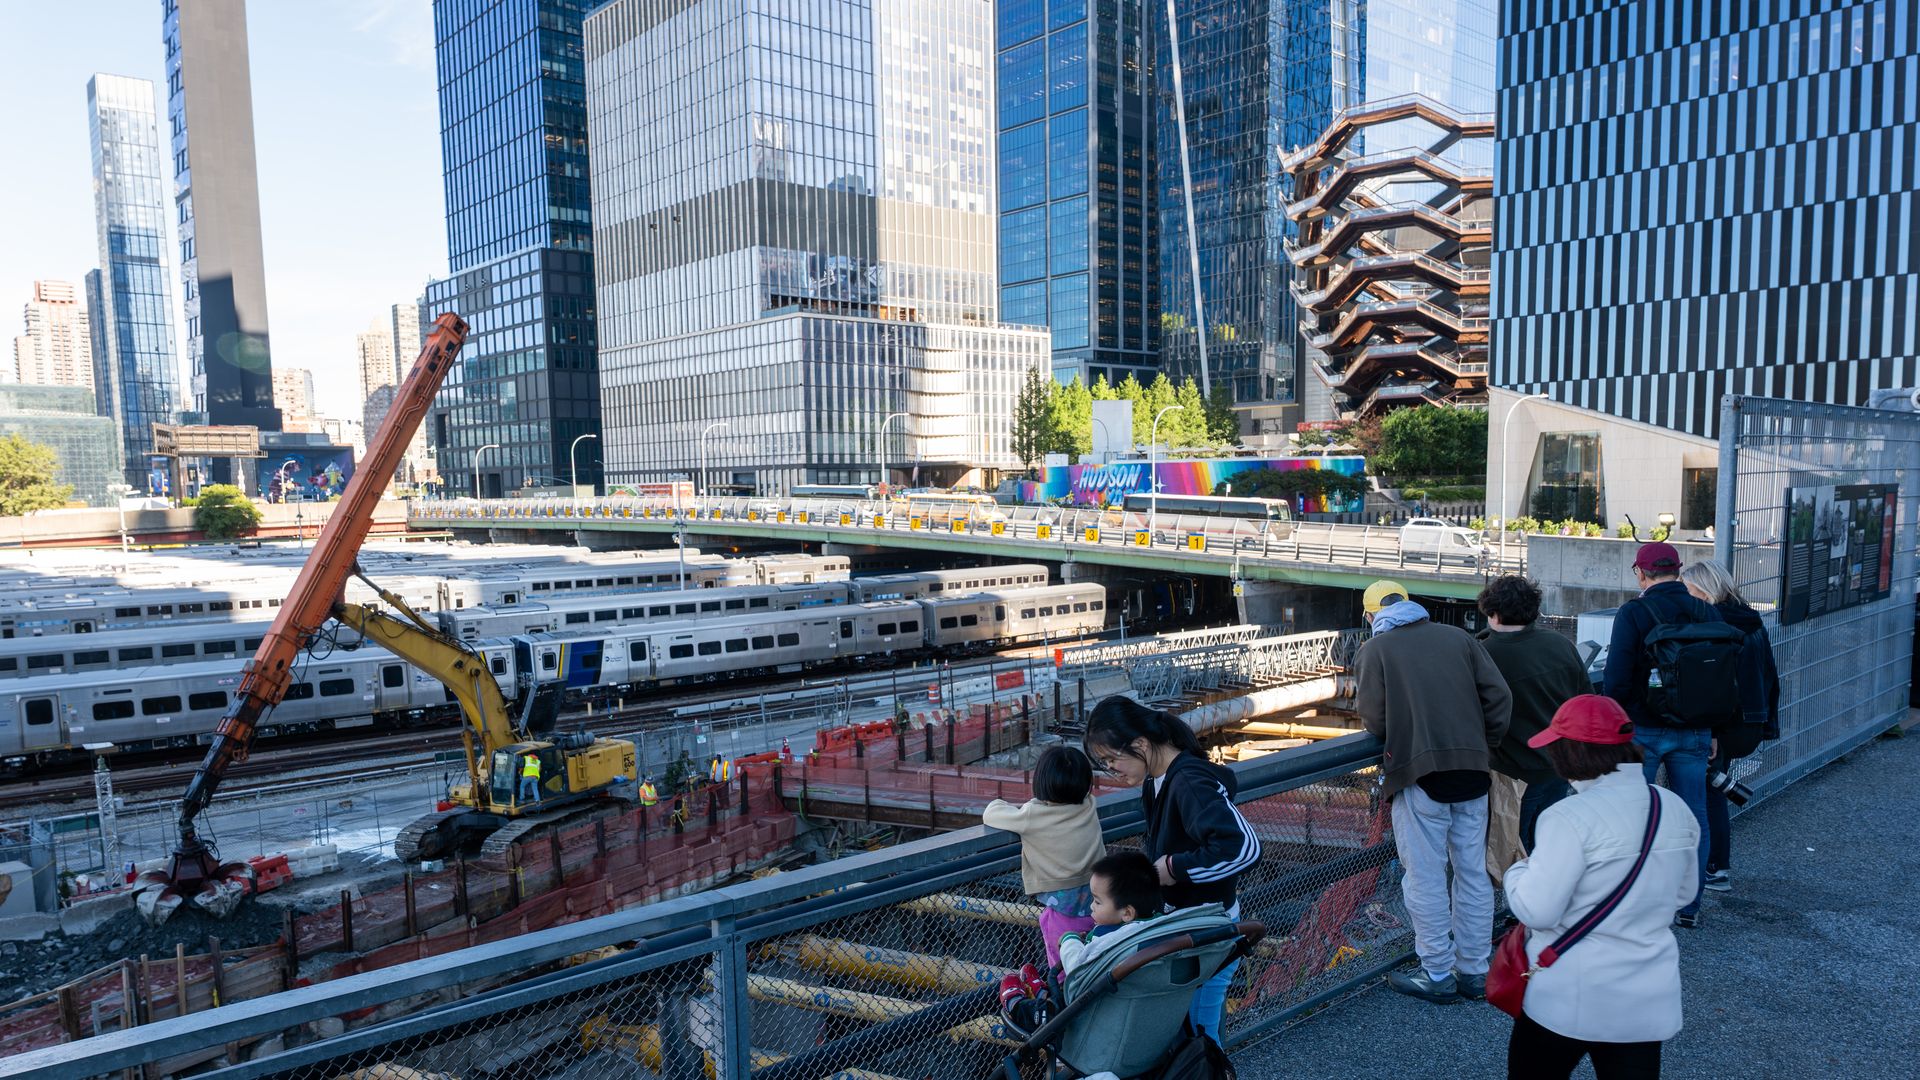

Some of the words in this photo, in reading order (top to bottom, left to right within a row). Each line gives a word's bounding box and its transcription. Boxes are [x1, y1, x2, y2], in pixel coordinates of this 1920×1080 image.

[1079, 463, 1141, 491] HUDSON
[955, 521, 961, 531] 6
[995, 523, 1000, 534] 5
[1040, 526, 1046, 538] 4
[1088, 529, 1095, 541] 3
[1139, 533, 1146, 545] 2
